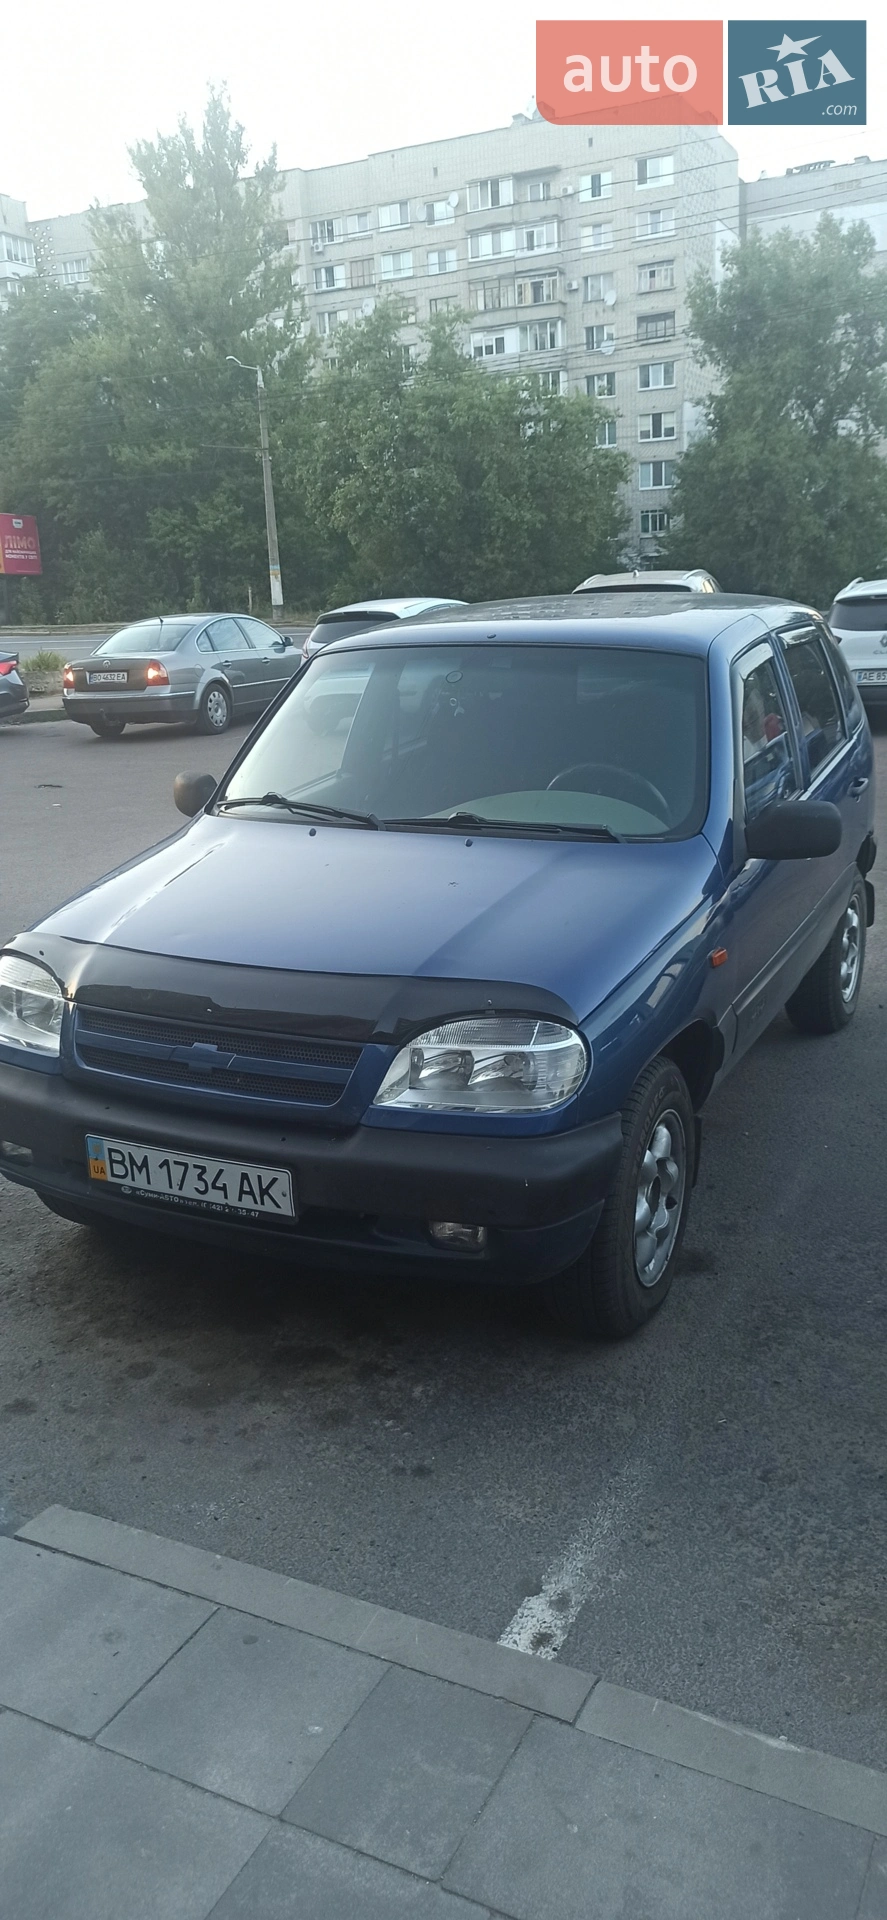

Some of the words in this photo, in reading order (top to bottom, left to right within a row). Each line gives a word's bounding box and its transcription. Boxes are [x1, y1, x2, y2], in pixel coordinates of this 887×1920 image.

[4, 535, 36, 549] ЛІМО
[117, 673, 126, 681] EA
[862, 672, 875, 681] AE
[876, 672, 887, 681] 85
[93, 1166, 106, 1175] UA
[107, 1147, 151, 1185] BM
[158, 1158, 229, 1200] 1734
[237, 1172, 282, 1209] AK
